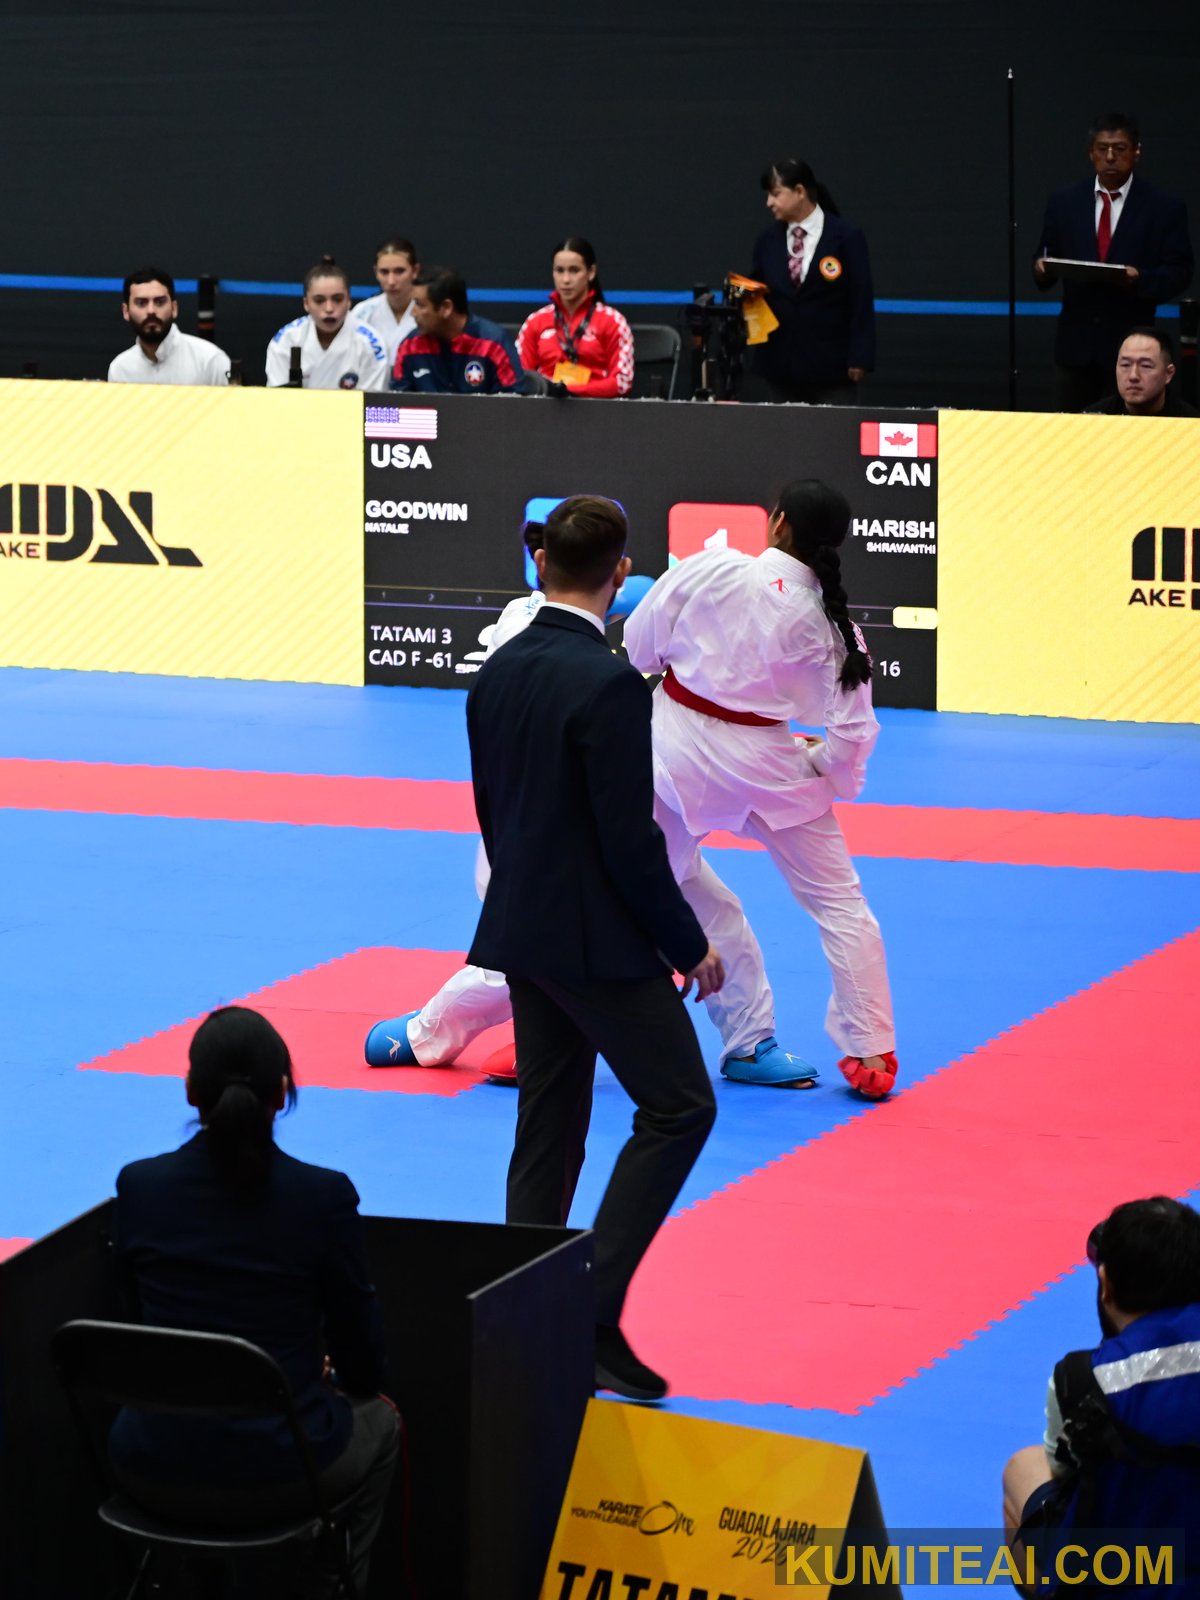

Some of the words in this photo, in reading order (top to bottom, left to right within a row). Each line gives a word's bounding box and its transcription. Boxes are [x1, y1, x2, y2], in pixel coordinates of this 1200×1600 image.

[370, 443, 432, 469] USA
[865, 460, 931, 487] CAN
[365, 500, 468, 521] GOODWIN
[364, 522, 409, 534] NATALIE
[852, 518, 935, 539] HARISH
[866, 541, 936, 554] SHRAVANTHI
[1128, 587, 1186, 608] AKE
[370, 625, 436, 643] TATAMI
[441, 628, 452, 644] 3
[368, 649, 407, 666] CAD
[411, 651, 421, 668] F
[425, 652, 452, 669] -61
[879, 660, 901, 677] 16
[597, 1499, 644, 1518] KARATE
[718, 1506, 817, 1546] GUADALAJARA
